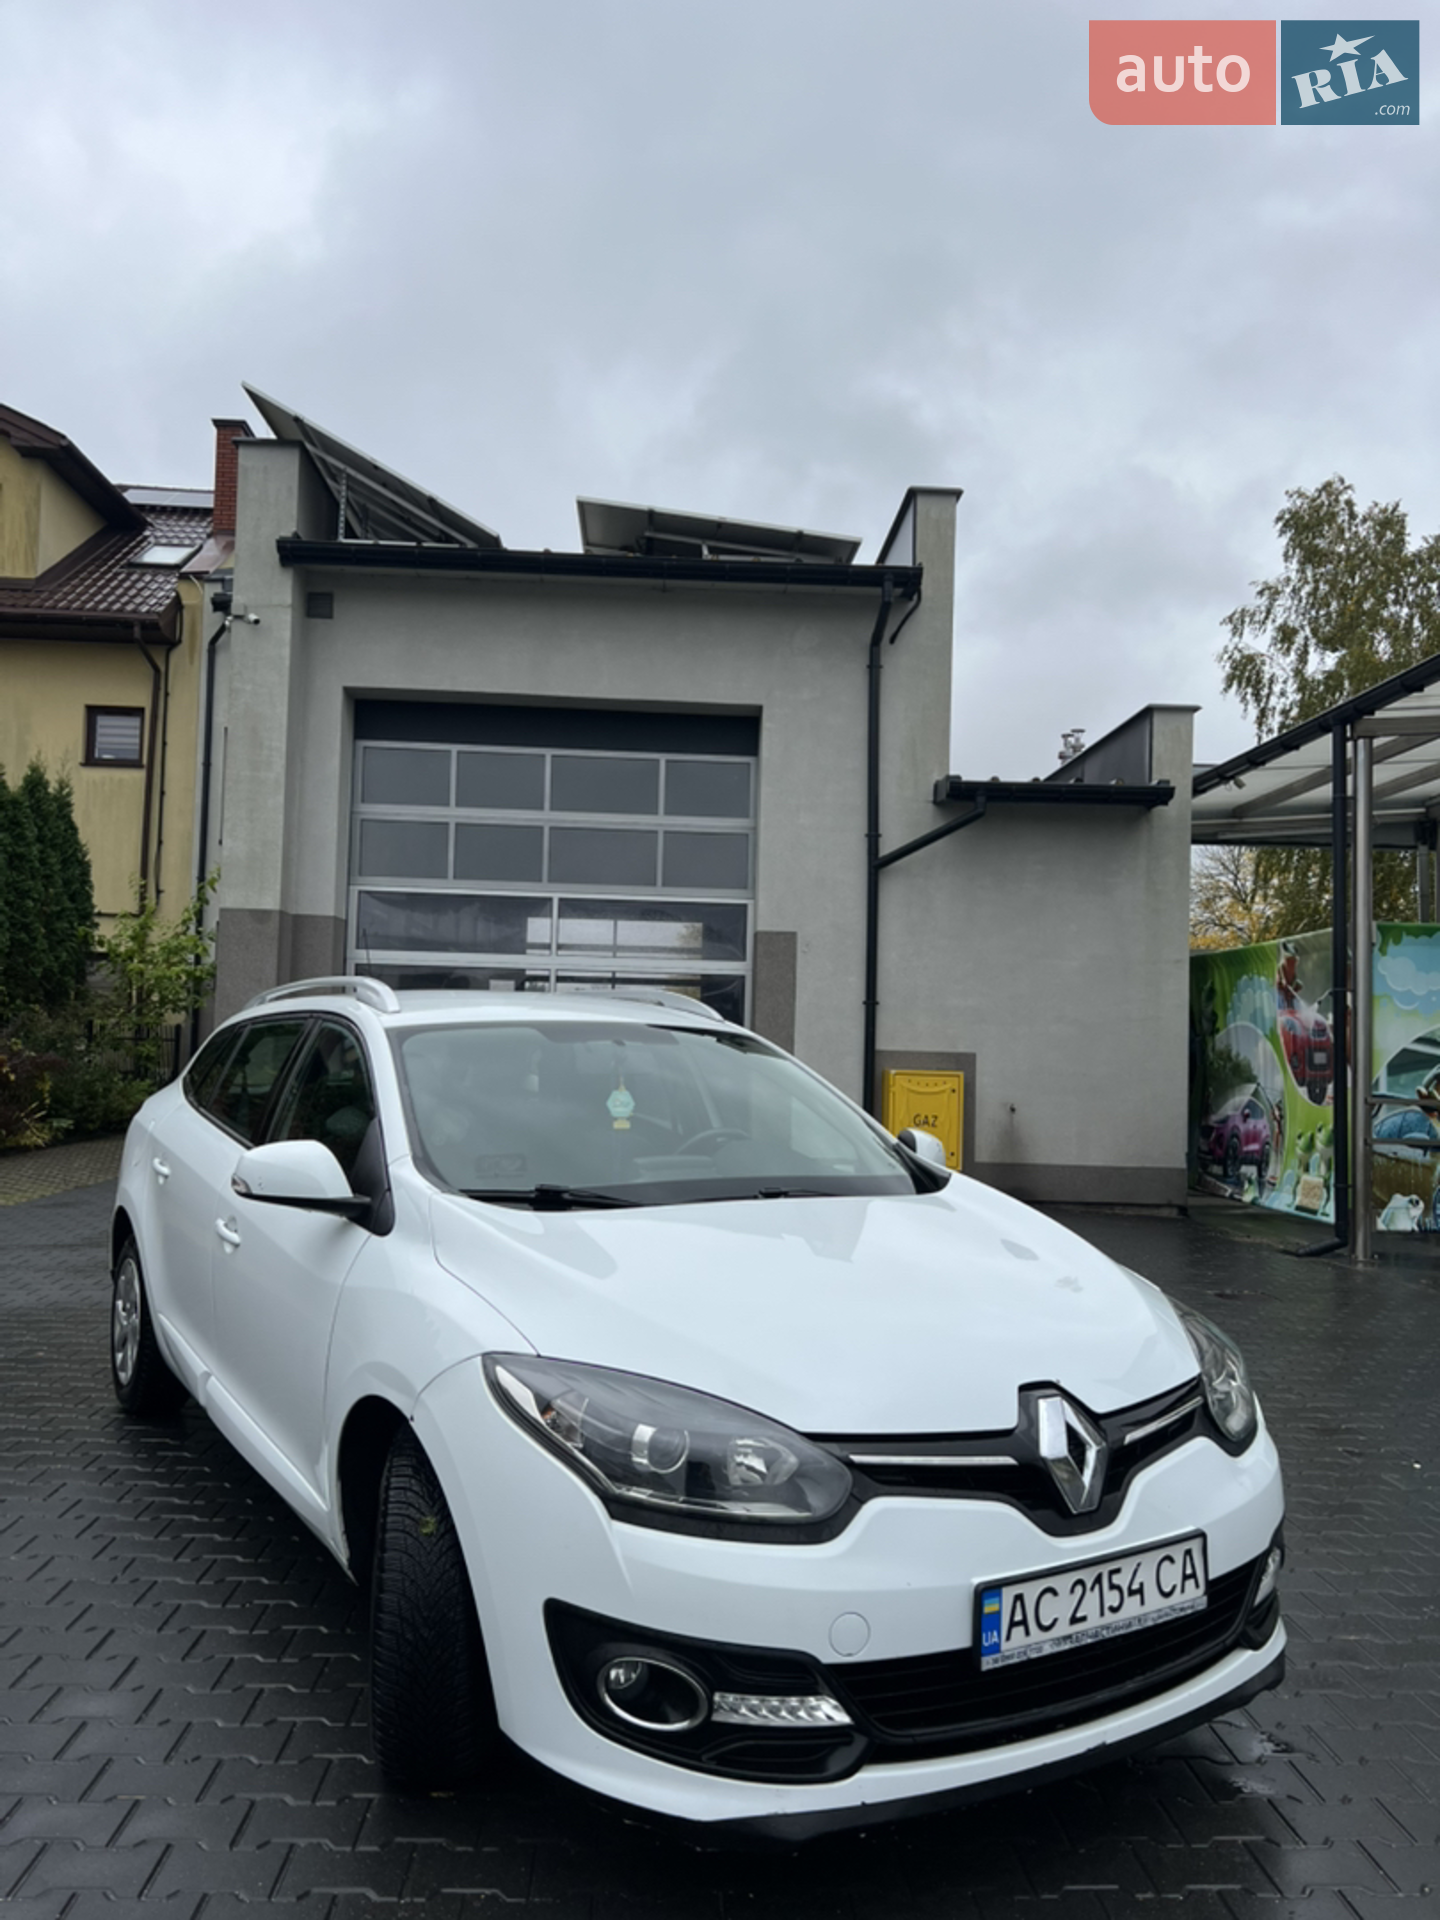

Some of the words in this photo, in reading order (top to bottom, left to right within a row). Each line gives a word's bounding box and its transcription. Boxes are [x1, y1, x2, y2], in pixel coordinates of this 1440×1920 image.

[913, 1113, 939, 1128] GAZ
[1005, 1585, 1060, 1643] AC
[1068, 1561, 1146, 1627] 2154
[1155, 1548, 1201, 1599] CA
[982, 1630, 1000, 1647] UA
